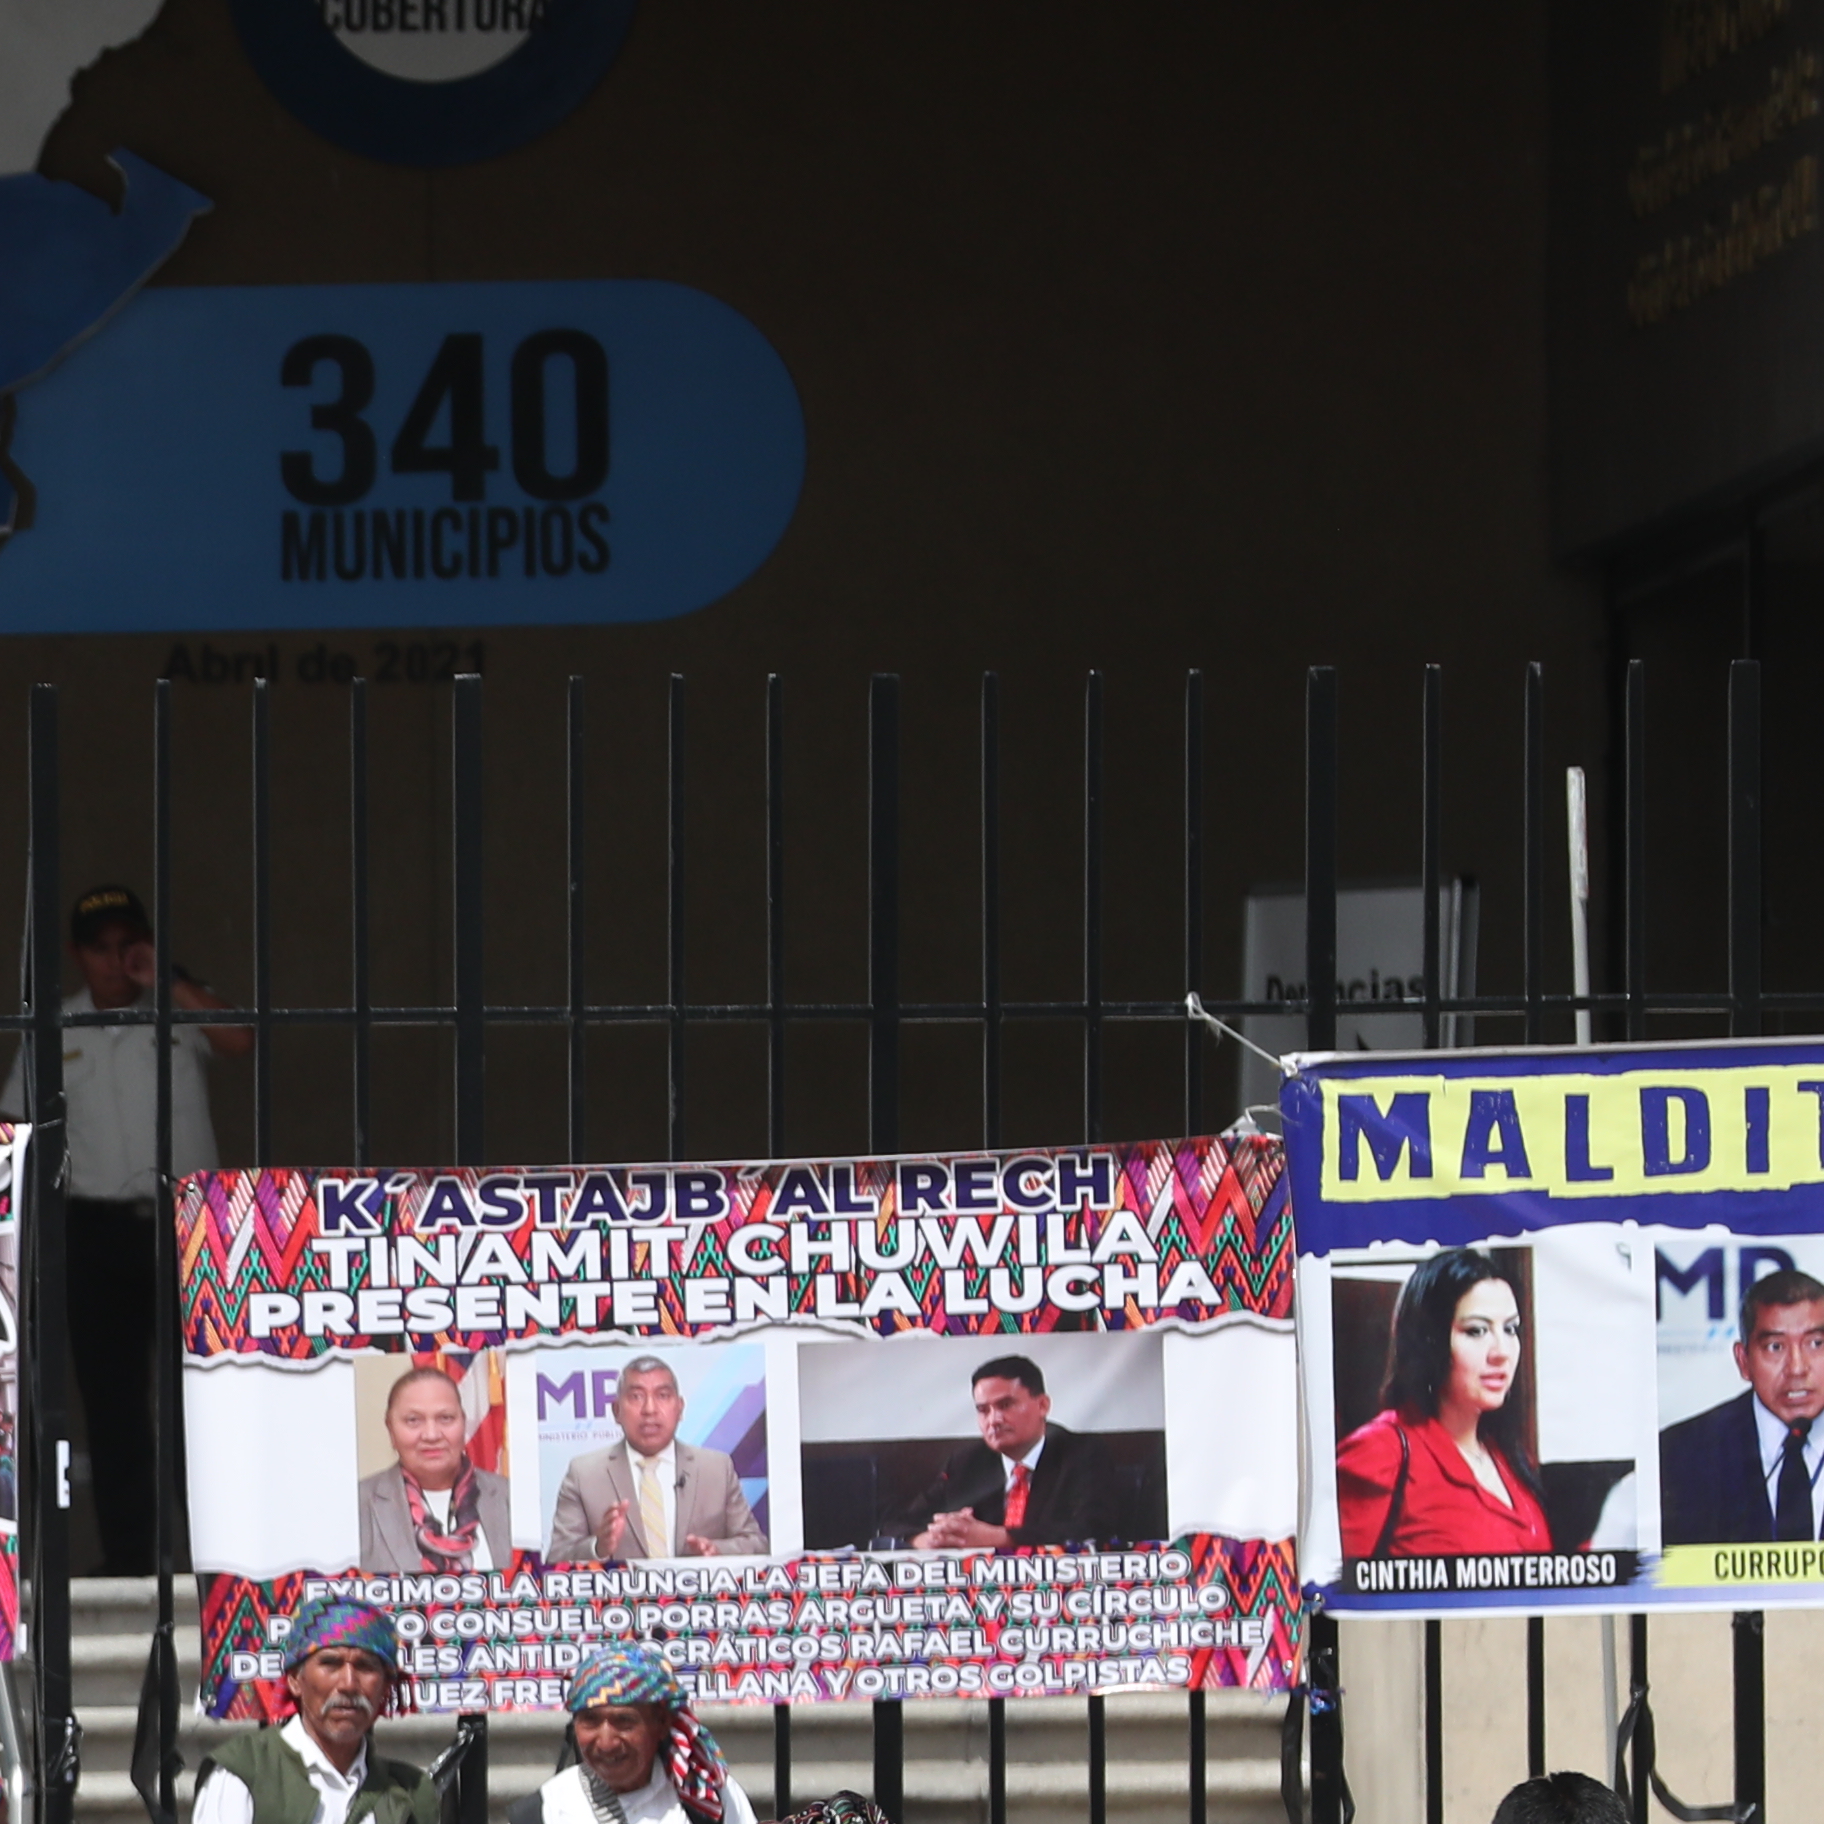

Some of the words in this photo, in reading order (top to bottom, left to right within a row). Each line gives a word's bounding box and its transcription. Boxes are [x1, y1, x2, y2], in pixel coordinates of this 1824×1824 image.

[279, 327, 610, 506] 340
[280, 502, 611, 582] MUNICIPIOS
[163, 641, 279, 684] Abril
[297, 640, 356, 683] de
[374, 638, 487, 683] 2021
[896, 1153, 1116, 1218] RECH
[311, 1226, 687, 1289] TINAMIT
[728, 1211, 1159, 1274] CHUWILA
[249, 1280, 658, 1338] PRESENTE
[685, 1274, 789, 1323] EN
[816, 1272, 921, 1318] LA
[945, 1261, 1221, 1315] LUCHA
[493, 1573, 539, 1600] LA
[547, 1567, 738, 1598] RENUNCIA
[745, 1566, 795, 1592] LA
[799, 1562, 889, 1591] JEFA
[896, 1559, 969, 1587] DEL
[974, 1551, 1189, 1584] MINISTERIO
[1356, 1558, 1449, 1591] CINTHIA
[1456, 1554, 1617, 1588] MONTERROSO
[1714, 1548, 1824, 1581] CURRUP
[432, 1604, 633, 1637] CONSUELO
[639, 1600, 791, 1631] PORRAS
[797, 1595, 974, 1628] ARGUETA
[976, 1594, 1006, 1620] Y
[1010, 1590, 1060, 1617] SU
[1067, 1582, 1229, 1617] CÍRCULO
[850, 1628, 994, 1660] RAFAEL
[1001, 1618, 1265, 1653] CURRUCHICHE
[821, 1668, 850, 1696] Y
[855, 1663, 982, 1696] OTROS
[989, 1657, 1190, 1691] GOLPISTAS
